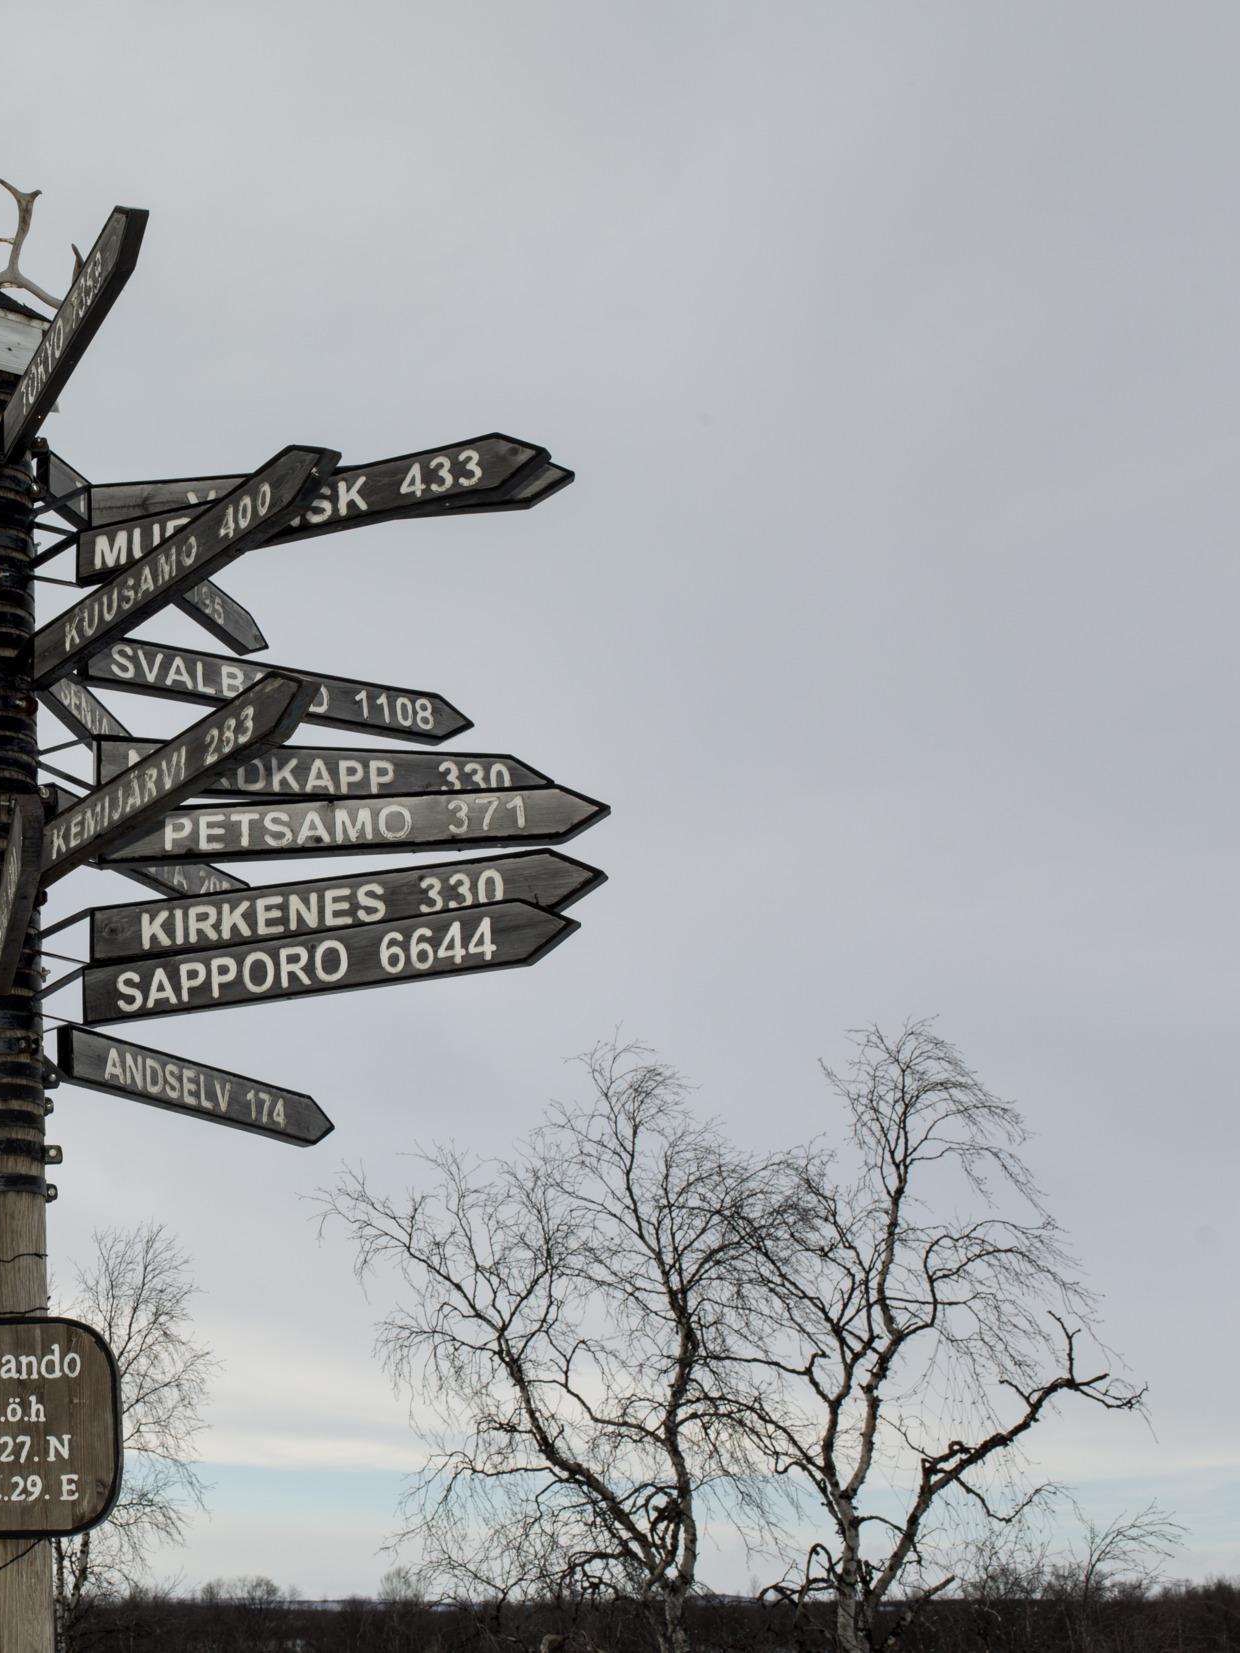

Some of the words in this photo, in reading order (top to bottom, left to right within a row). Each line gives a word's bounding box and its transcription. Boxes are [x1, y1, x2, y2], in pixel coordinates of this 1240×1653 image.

[20, 317, 65, 415] TOKYO
[94, 475, 369, 569] MUSK
[400, 449, 484, 498] 433
[64, 535, 198, 652] KUUSAMO
[218, 482, 272, 539] 400
[111, 644, 330, 714] SVALBD
[354, 690, 435, 730] 1108
[52, 745, 186, 860] KEMIJÄRVI
[204, 705, 254, 766] 283
[165, 805, 413, 852] PETSAMO
[447, 795, 527, 835] 371
[141, 883, 386, 950] KIRKENES
[419, 868, 504, 914] 330
[116, 940, 348, 1013] SAPPORO
[379, 917, 497, 973] 6644
[104, 1048, 232, 1116] ANDSELV
[245, 1089, 288, 1129] 174
[46, 1434, 71, 1462] N
[60, 1474, 79, 1500] E
